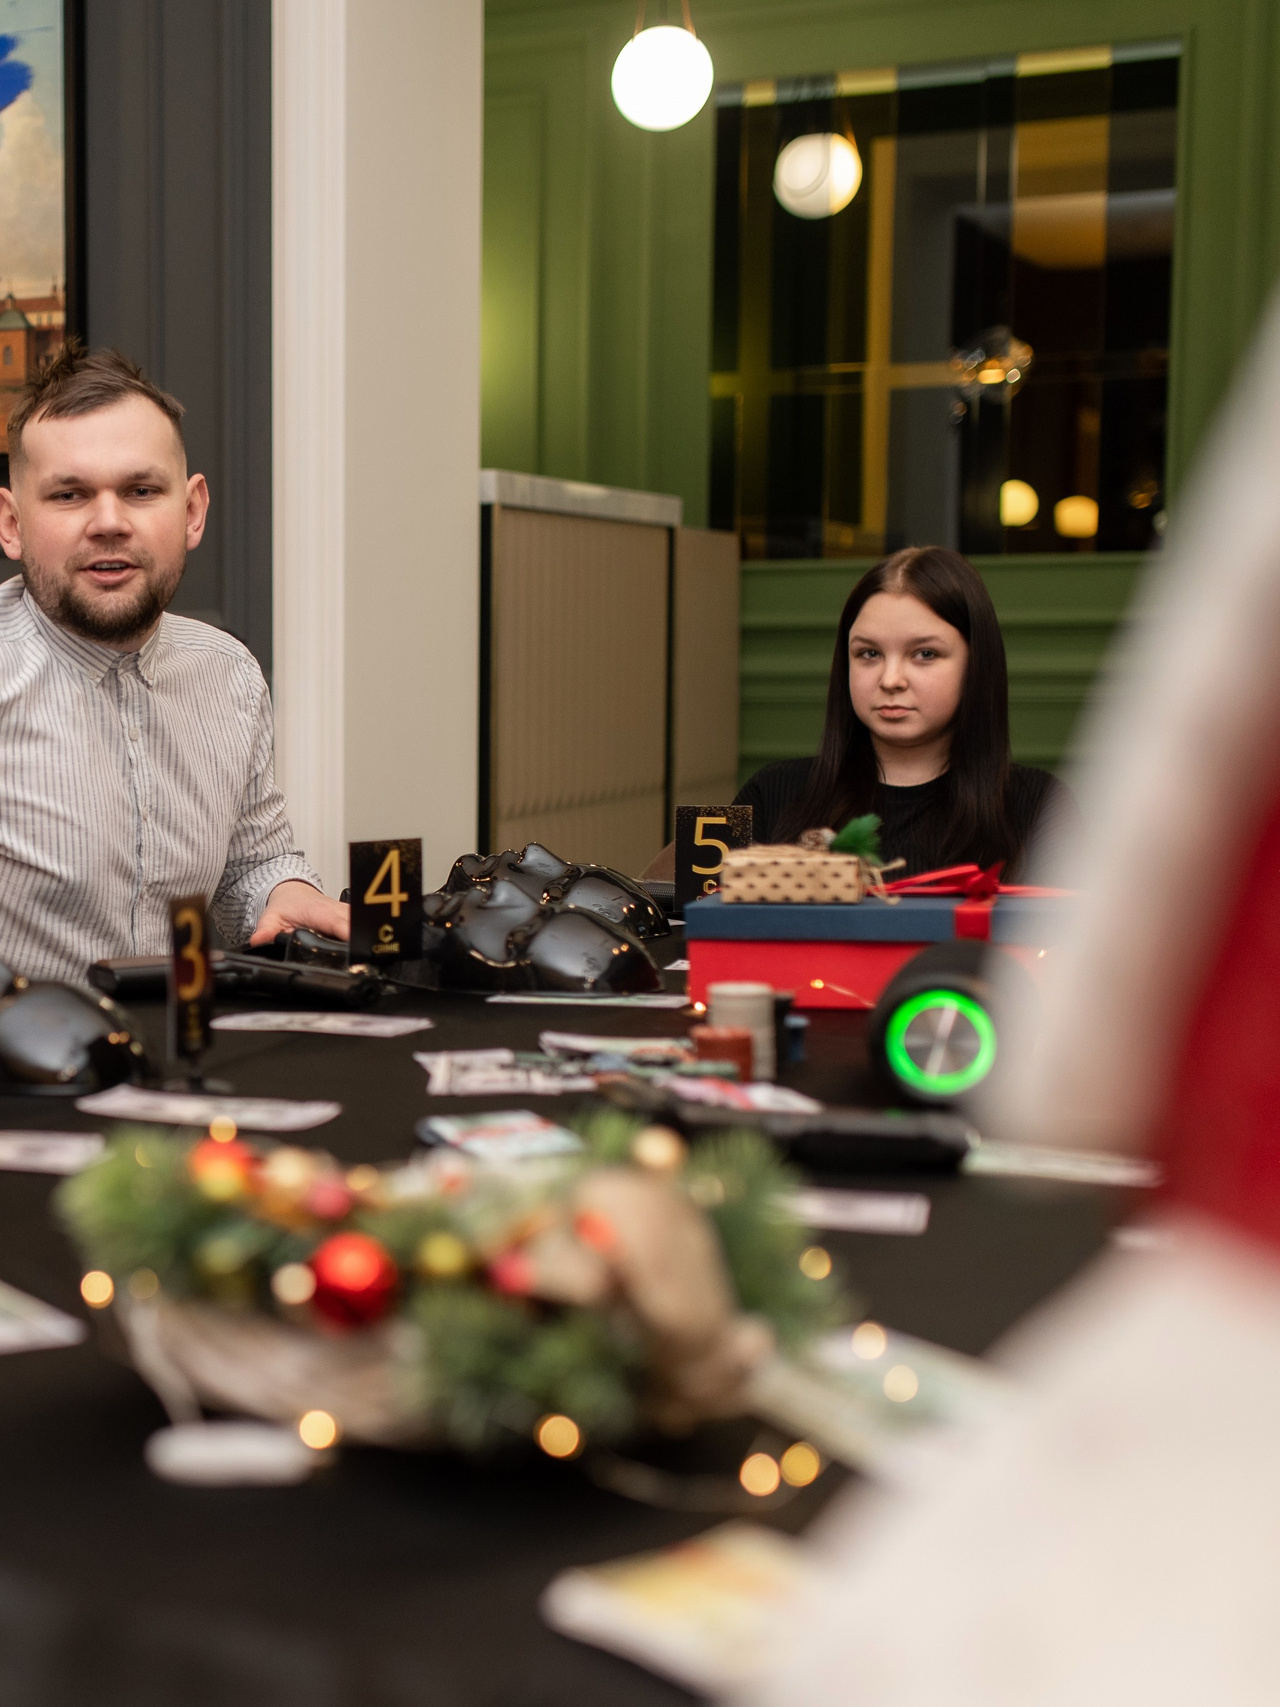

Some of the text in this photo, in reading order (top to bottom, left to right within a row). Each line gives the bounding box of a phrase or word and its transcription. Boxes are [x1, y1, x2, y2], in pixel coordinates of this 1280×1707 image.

[692, 817, 730, 875] 5
[363, 849, 409, 918] 4
[173, 906, 205, 1002] 3
[372, 943, 400, 954] CRIME
